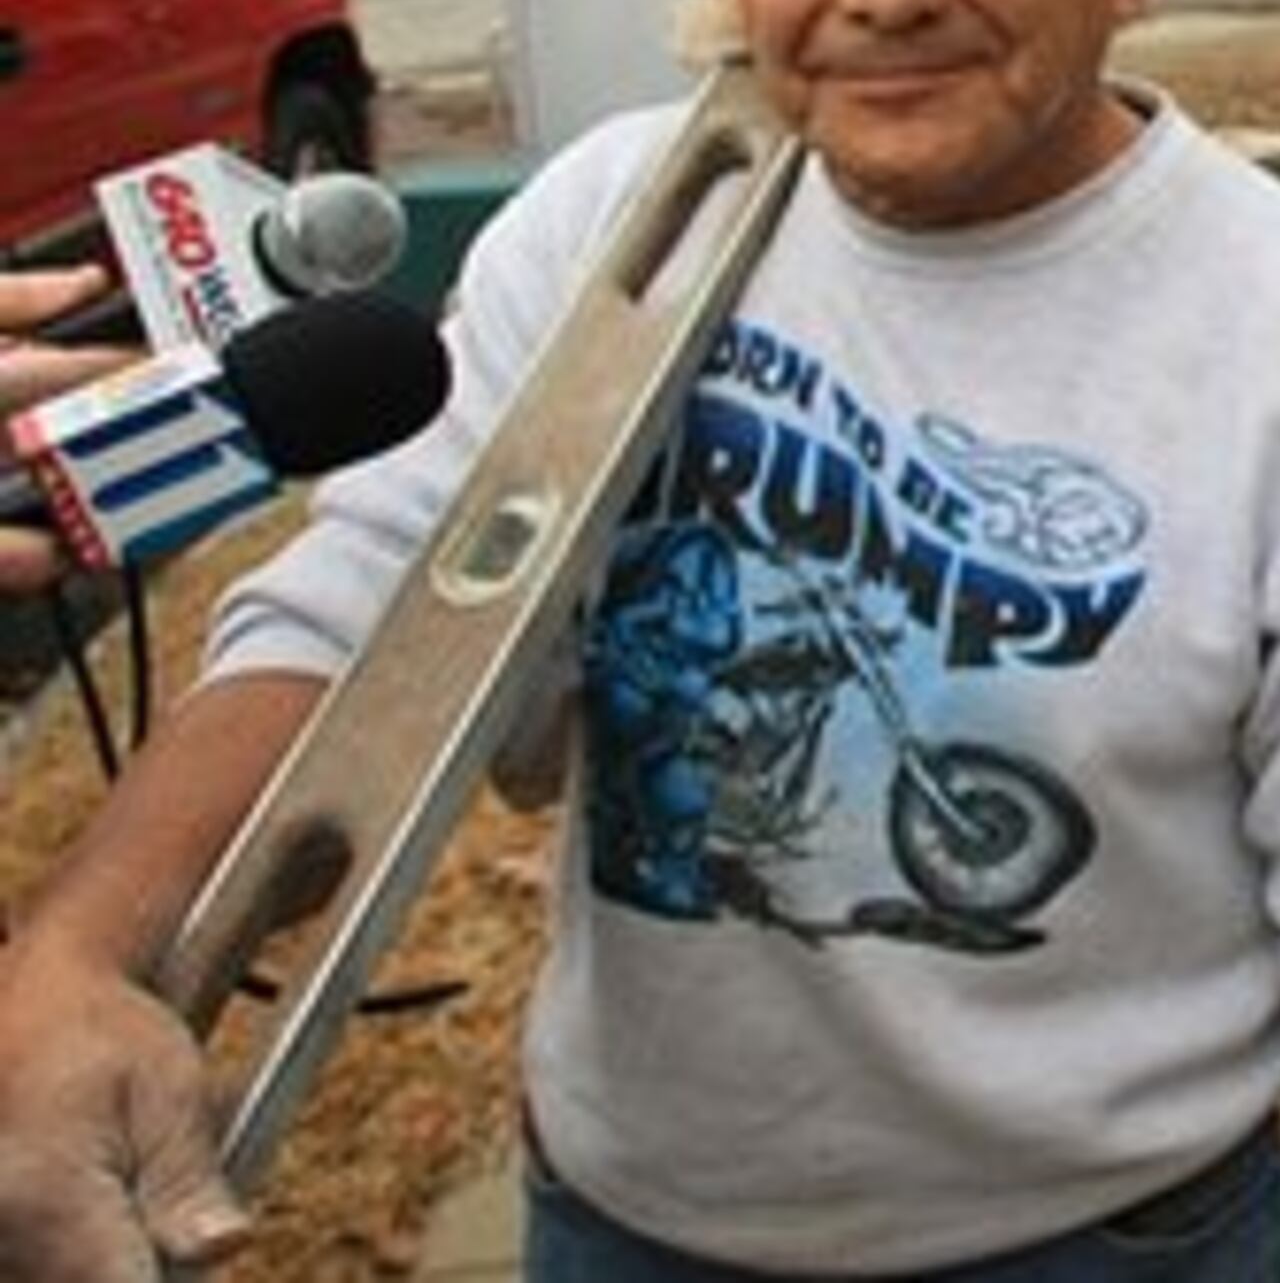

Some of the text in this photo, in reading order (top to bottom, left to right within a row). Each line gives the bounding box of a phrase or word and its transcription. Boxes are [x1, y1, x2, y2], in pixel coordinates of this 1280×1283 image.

[650, 390, 1146, 668] RUMPY
[700, 320, 976, 543] ORN TO BE
